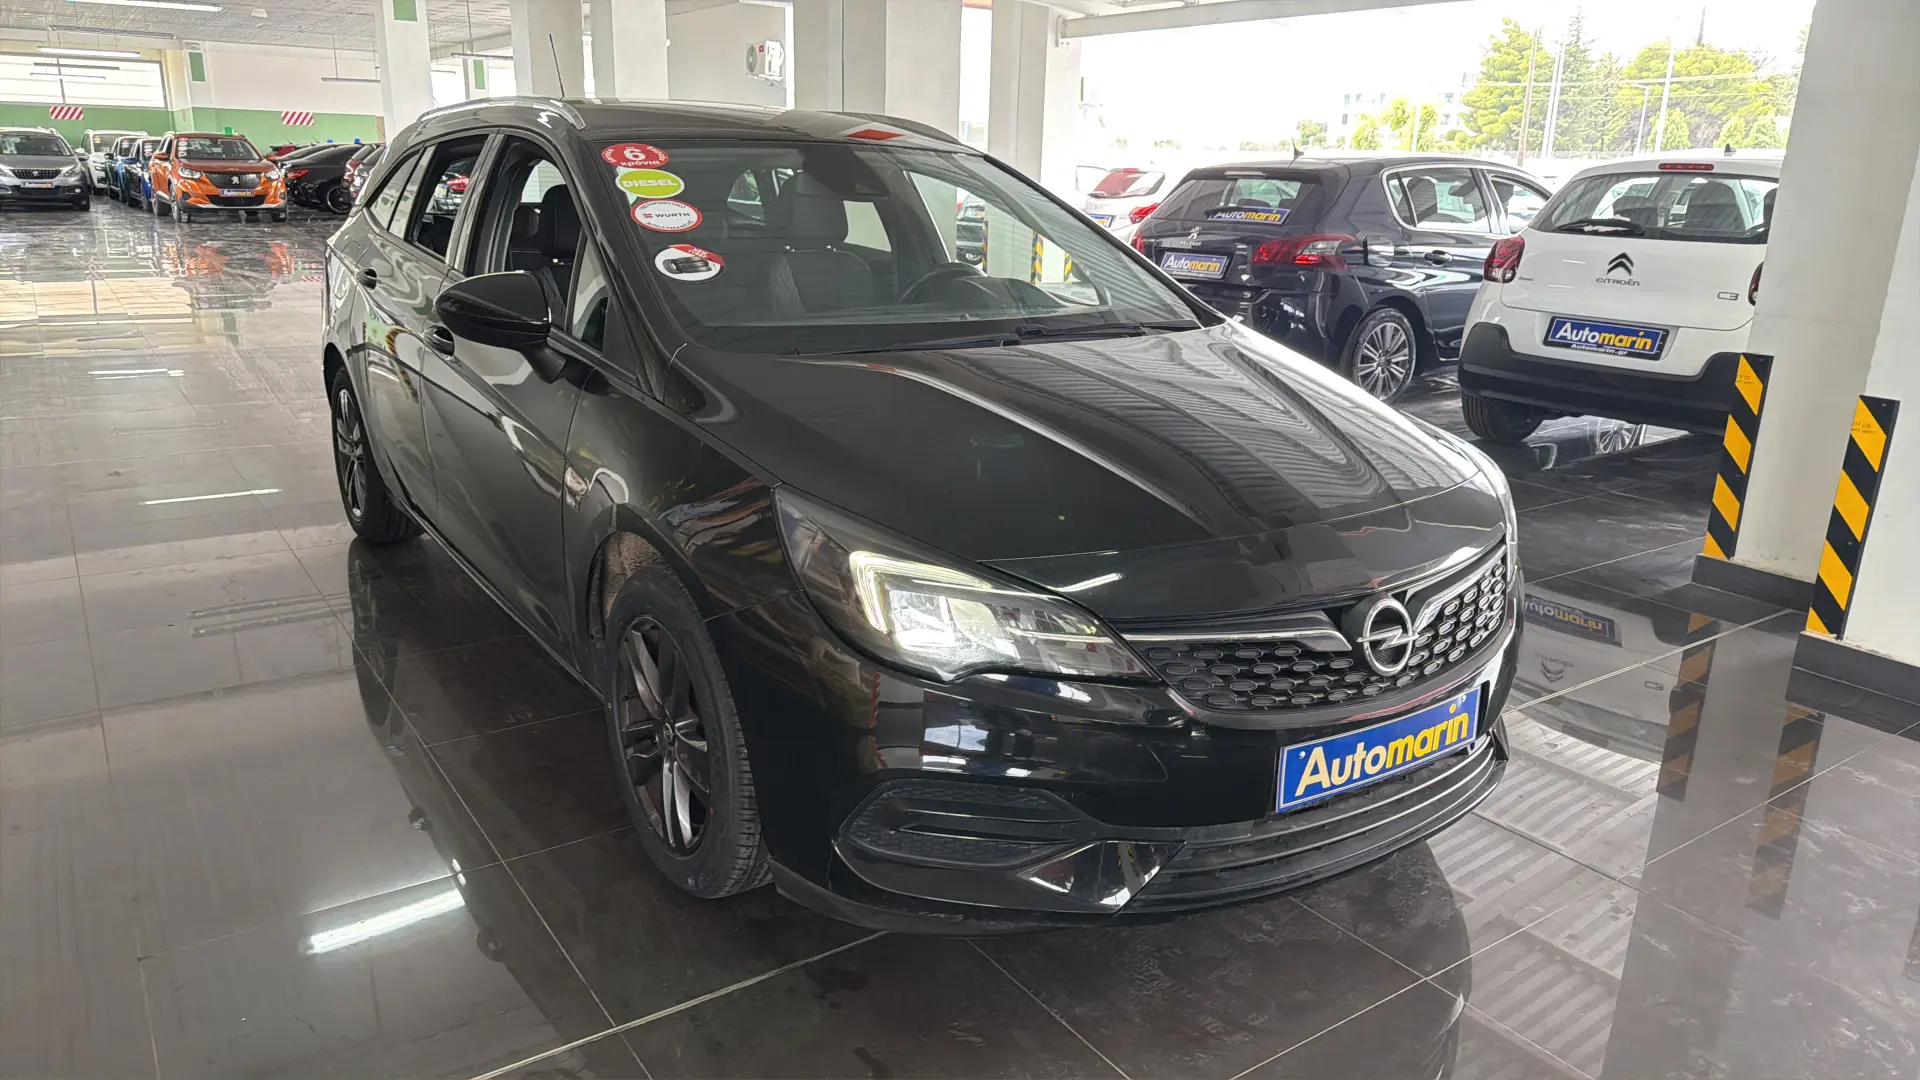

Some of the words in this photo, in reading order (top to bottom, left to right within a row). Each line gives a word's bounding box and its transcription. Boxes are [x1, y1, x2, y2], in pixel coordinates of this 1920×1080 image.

[624, 148, 646, 161] 6
[621, 179, 678, 187] DIESEL
[1164, 254, 1221, 272] Automarin
[1717, 291, 1740, 301] C3
[1555, 322, 1653, 351] Automarin
[1570, 343, 1629, 356] Automarin.gr
[1294, 703, 1469, 797] Automarin
